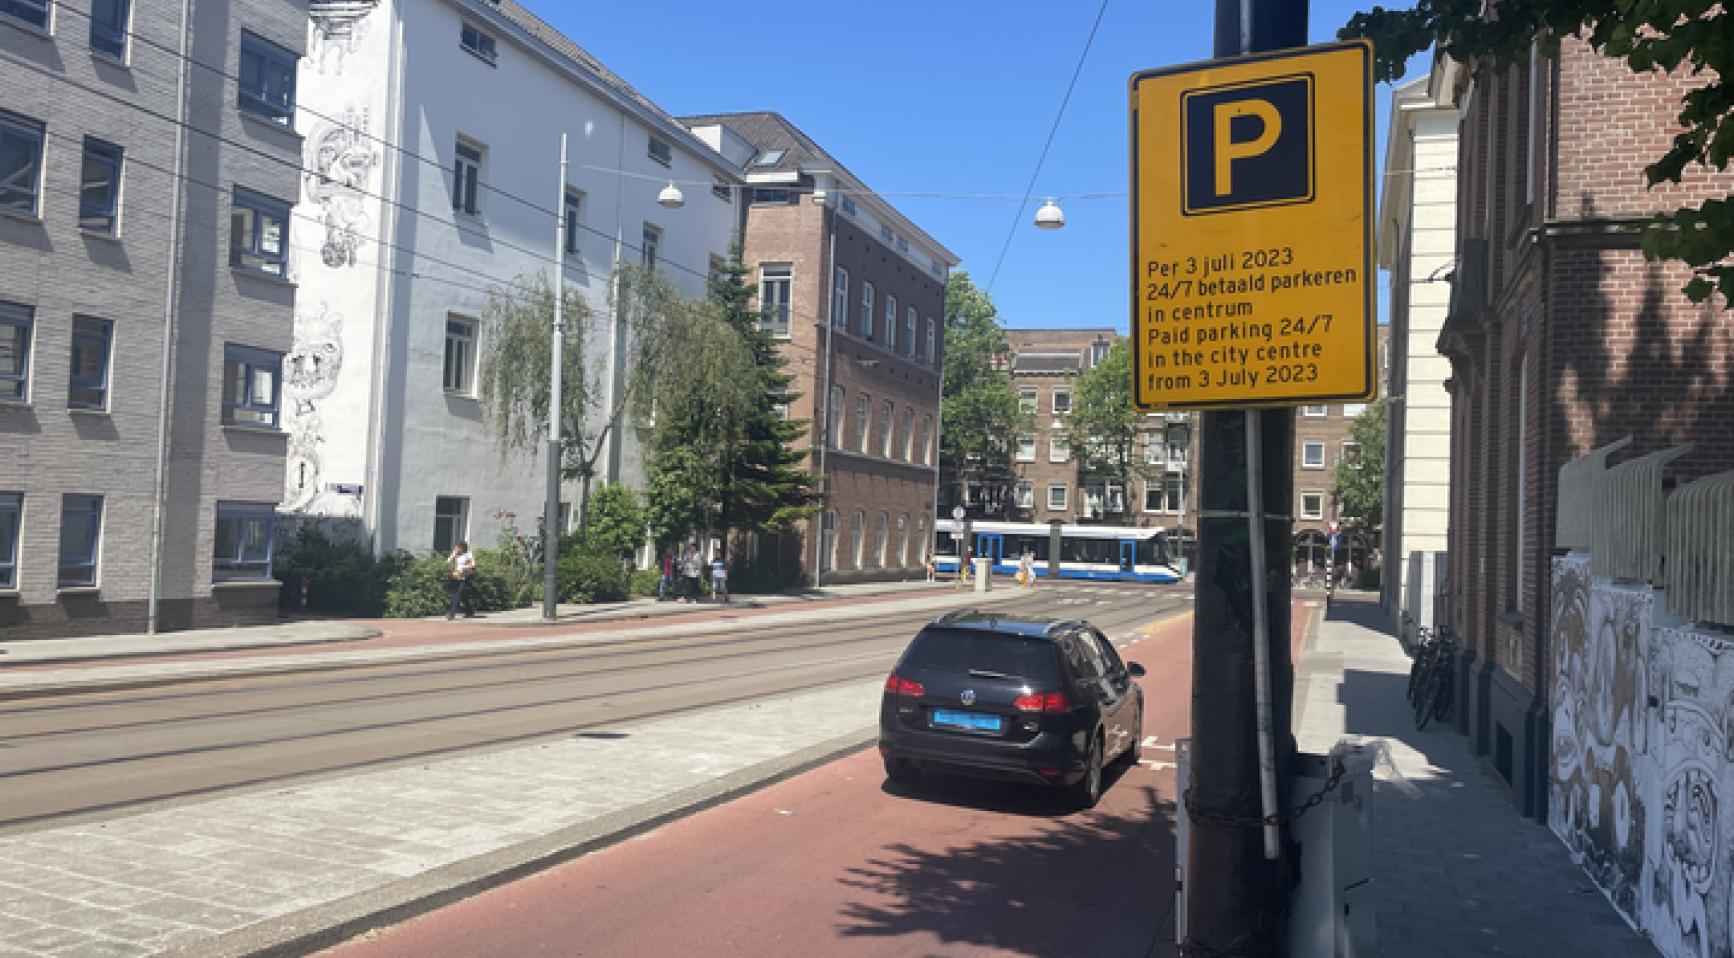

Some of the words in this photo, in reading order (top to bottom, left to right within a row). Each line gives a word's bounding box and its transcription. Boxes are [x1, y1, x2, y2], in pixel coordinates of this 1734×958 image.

[1214, 98, 1282, 197] P
[1148, 261, 1179, 277] Per
[1186, 257, 1197, 274] 3
[1203, 253, 1234, 277] juli
[1242, 247, 1293, 269] 2023
[1147, 280, 1192, 300] 24/7
[1199, 273, 1265, 296] betaald
[1271, 268, 1356, 292] parkeren
[1149, 306, 1164, 323] in
[1172, 301, 1253, 320] centrum
[1149, 327, 1188, 346] Paid
[1197, 322, 1272, 344] parking
[1279, 315, 1333, 337] 24/7
[1149, 351, 1165, 368] in
[1173, 348, 1204, 366] the
[1211, 345, 1248, 365] city
[1256, 341, 1322, 361] centre
[1149, 373, 1190, 390] from
[1199, 370, 1210, 387] 3
[1216, 367, 1258, 388] July
[1266, 363, 1318, 383] 2023
